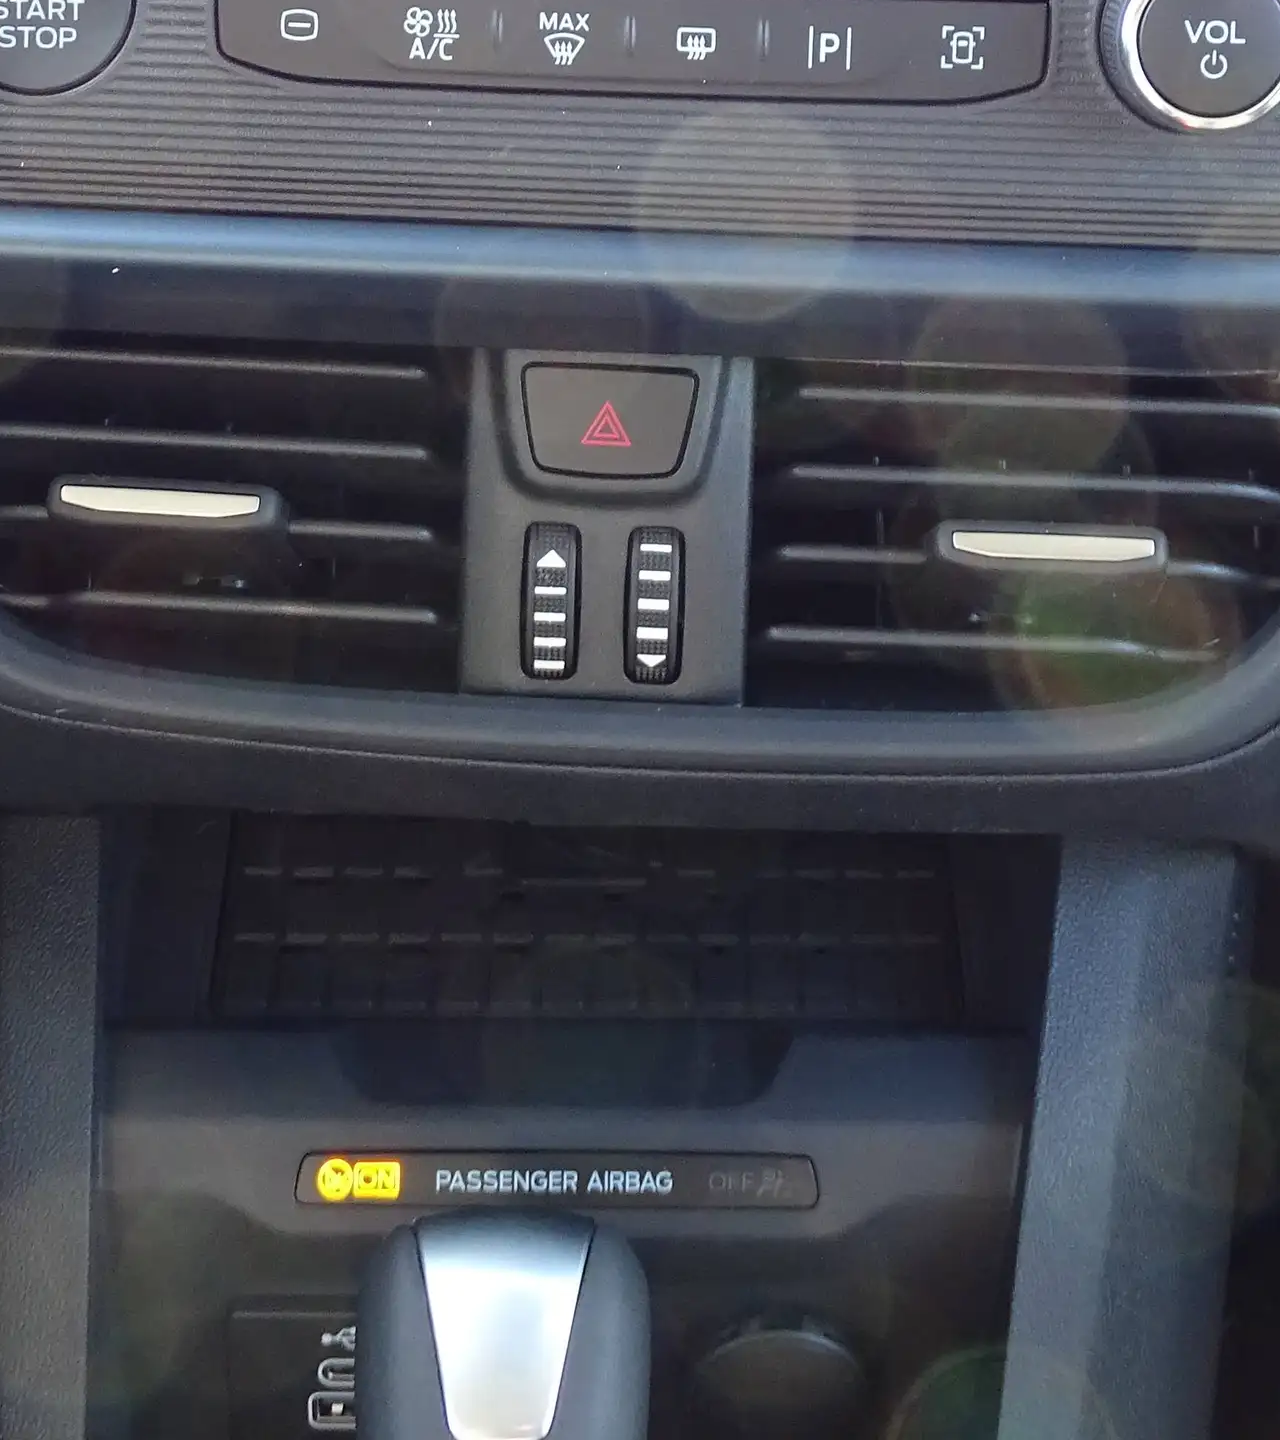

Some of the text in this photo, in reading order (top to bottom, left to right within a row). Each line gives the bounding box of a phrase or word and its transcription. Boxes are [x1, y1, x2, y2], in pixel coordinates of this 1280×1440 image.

[539, 12, 590, 32] MAX
[1185, 20, 1246, 45] VOL
[409, 38, 454, 62] A/C
[819, 33, 840, 63] P
[357, 1165, 397, 1191] ON
[436, 1169, 578, 1194] PASSENGER
[587, 1169, 674, 1194] AIRBAG
